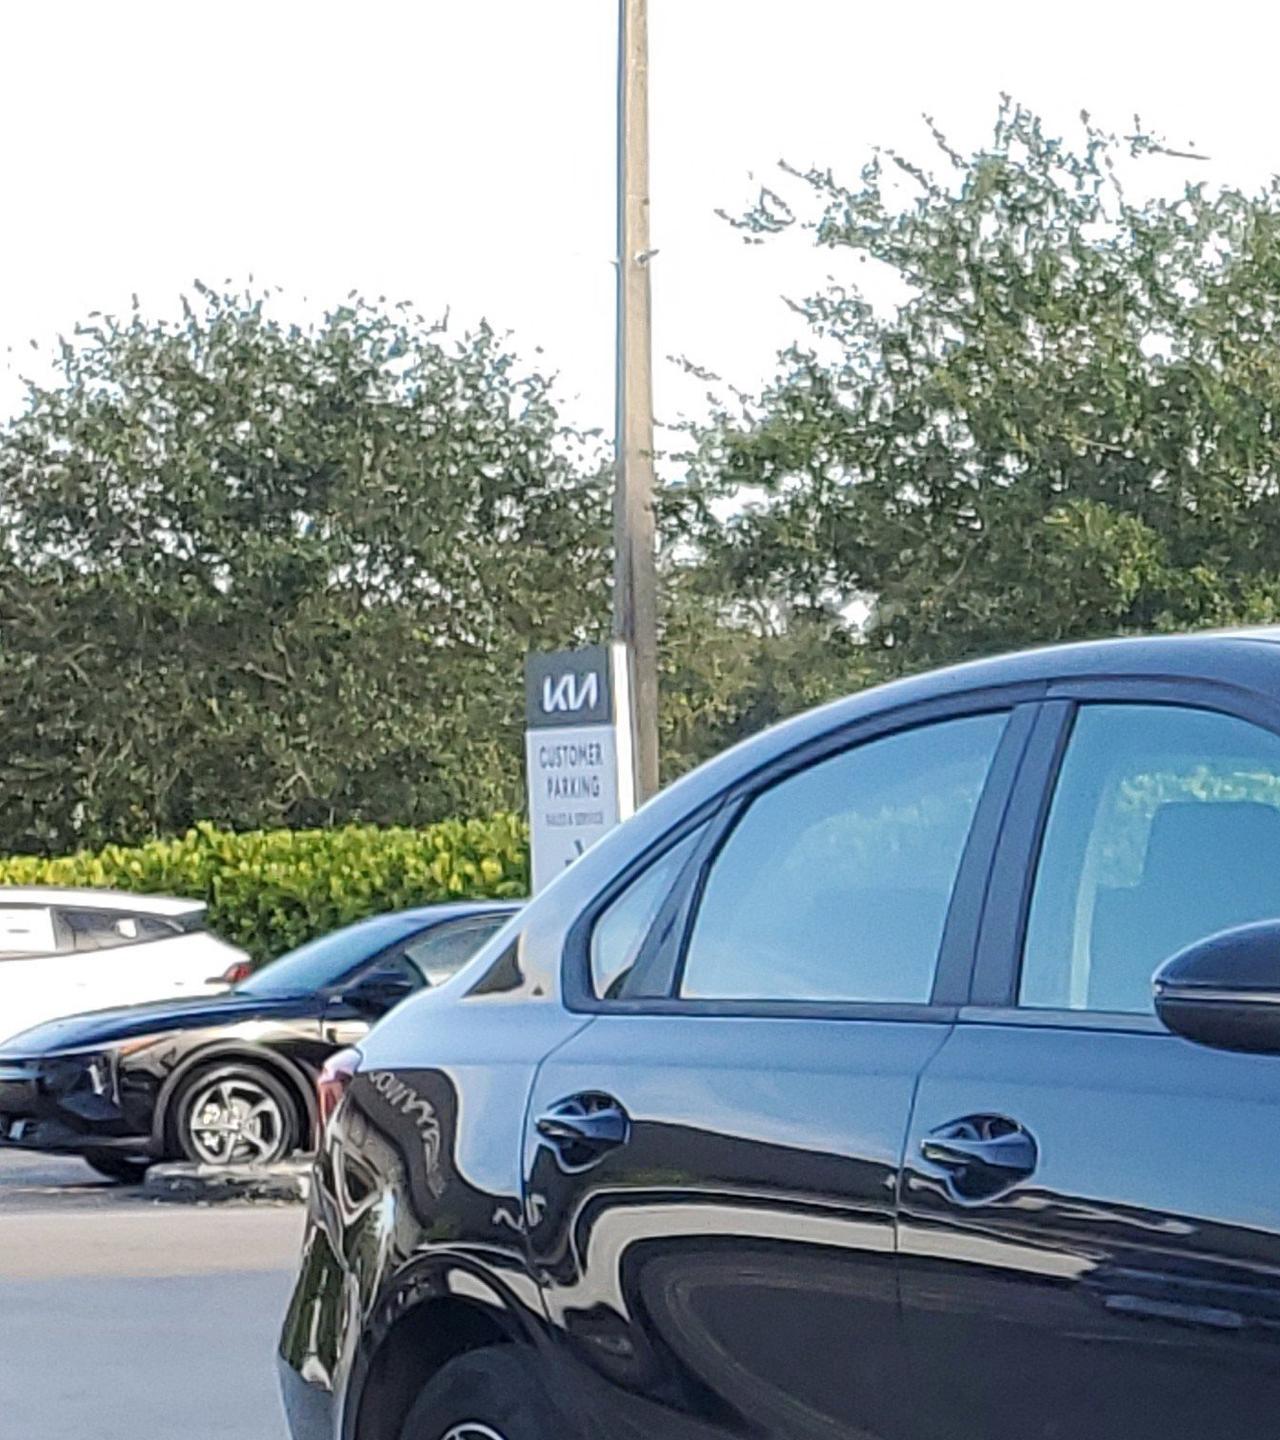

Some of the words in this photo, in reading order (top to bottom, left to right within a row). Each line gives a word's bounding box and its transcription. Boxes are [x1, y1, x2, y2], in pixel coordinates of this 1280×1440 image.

[543, 671, 598, 713] KIA
[539, 742, 603, 769] CUSTOMER
[547, 775, 600, 799] PARKING
